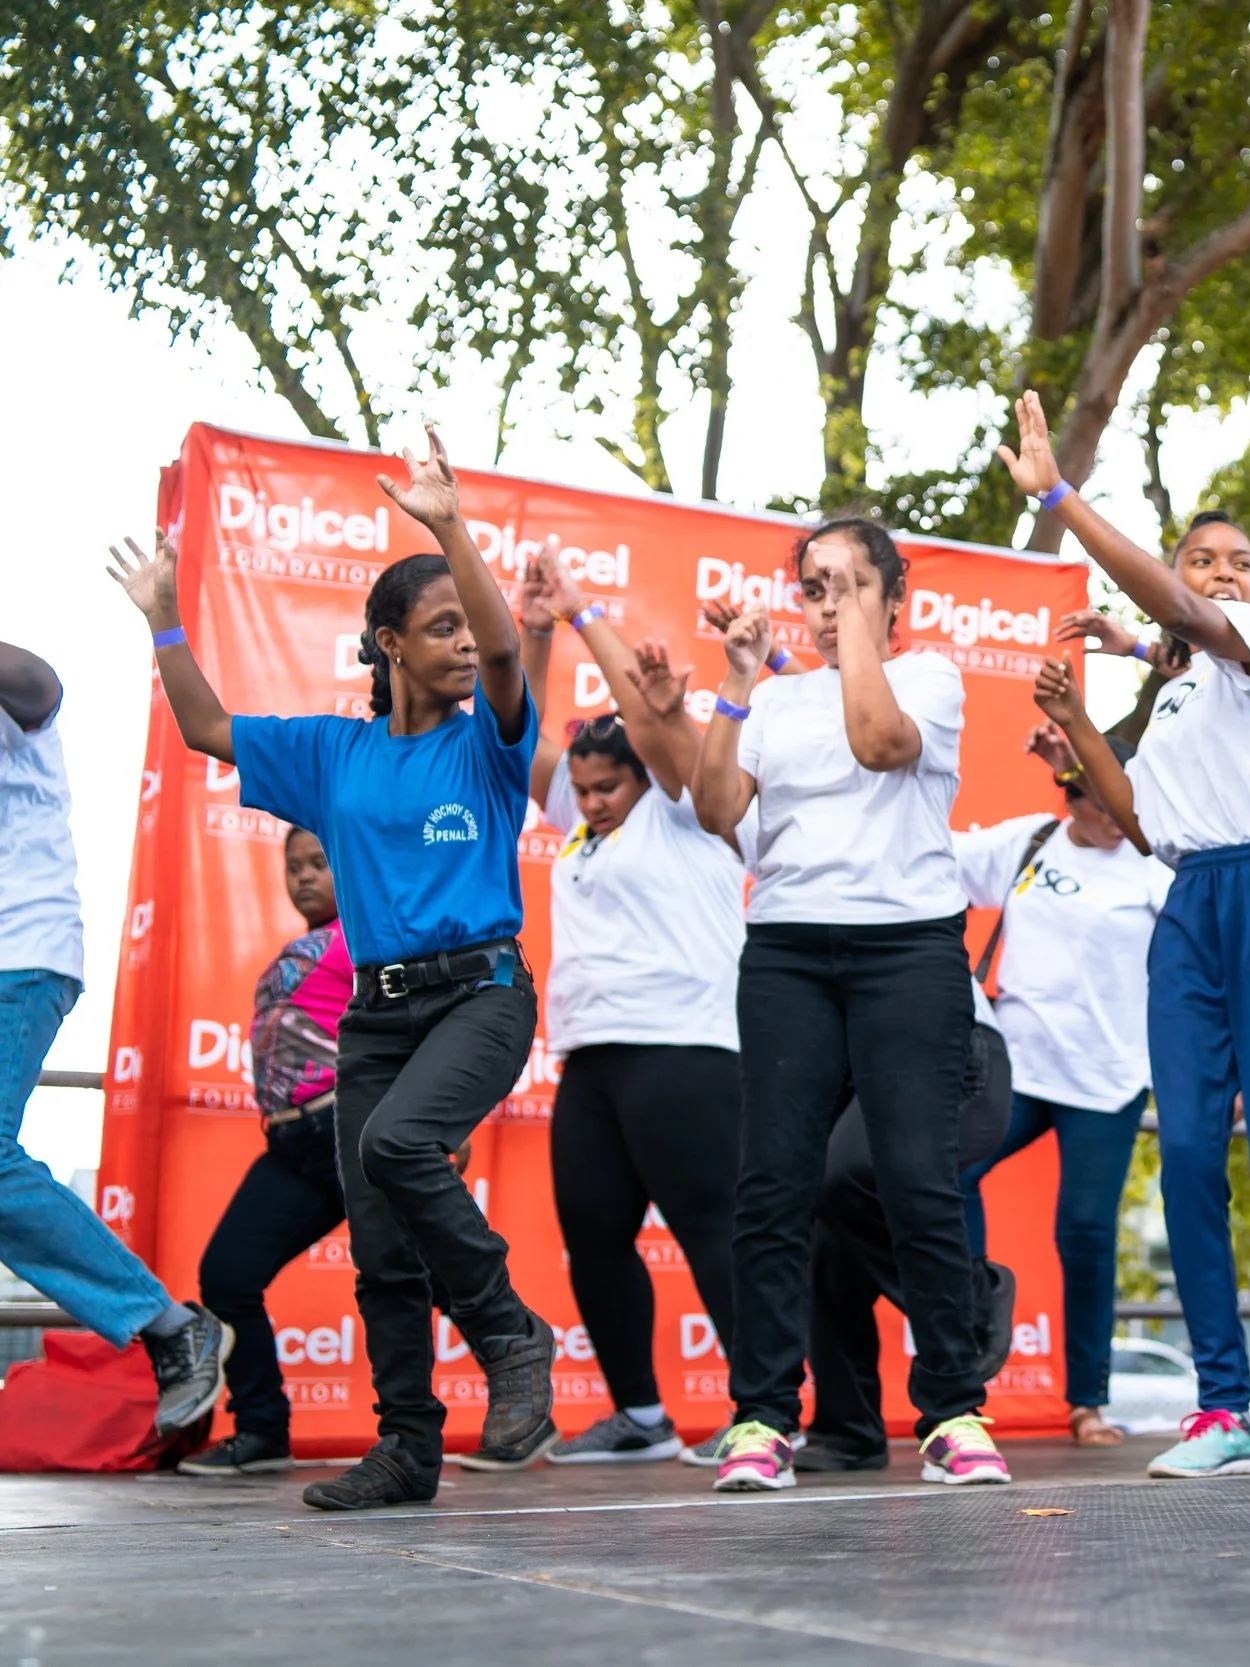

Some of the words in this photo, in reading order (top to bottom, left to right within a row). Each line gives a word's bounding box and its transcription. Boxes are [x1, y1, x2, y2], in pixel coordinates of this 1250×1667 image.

[219, 483, 389, 553] Digicel
[465, 519, 631, 588] Dicel
[696, 556, 803, 615] Digic
[909, 588, 1050, 648] Digicel
[423, 820, 435, 846] LADY
[428, 803, 464, 824] HOCHOY
[436, 829, 466, 842] PENAL
